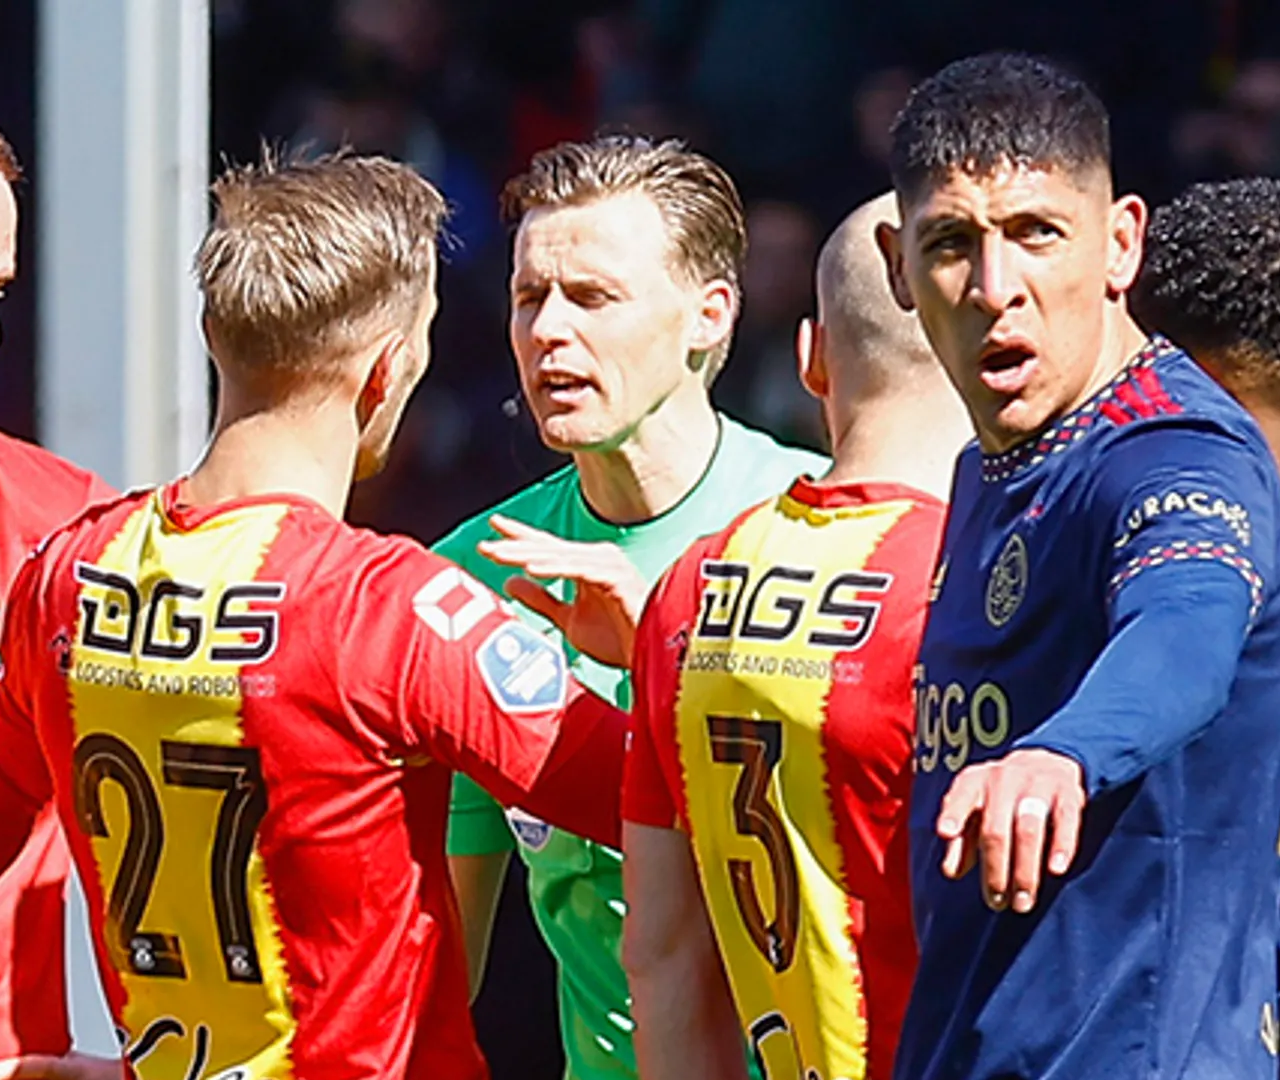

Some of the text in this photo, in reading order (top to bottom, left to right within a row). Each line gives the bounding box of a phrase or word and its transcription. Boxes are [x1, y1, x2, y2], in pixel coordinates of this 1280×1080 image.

[74, 560, 284, 664] DGS
[696, 559, 893, 652] DGS
[912, 662, 1009, 773] iggo
[73, 732, 269, 984] 27
[705, 714, 801, 973] 3
